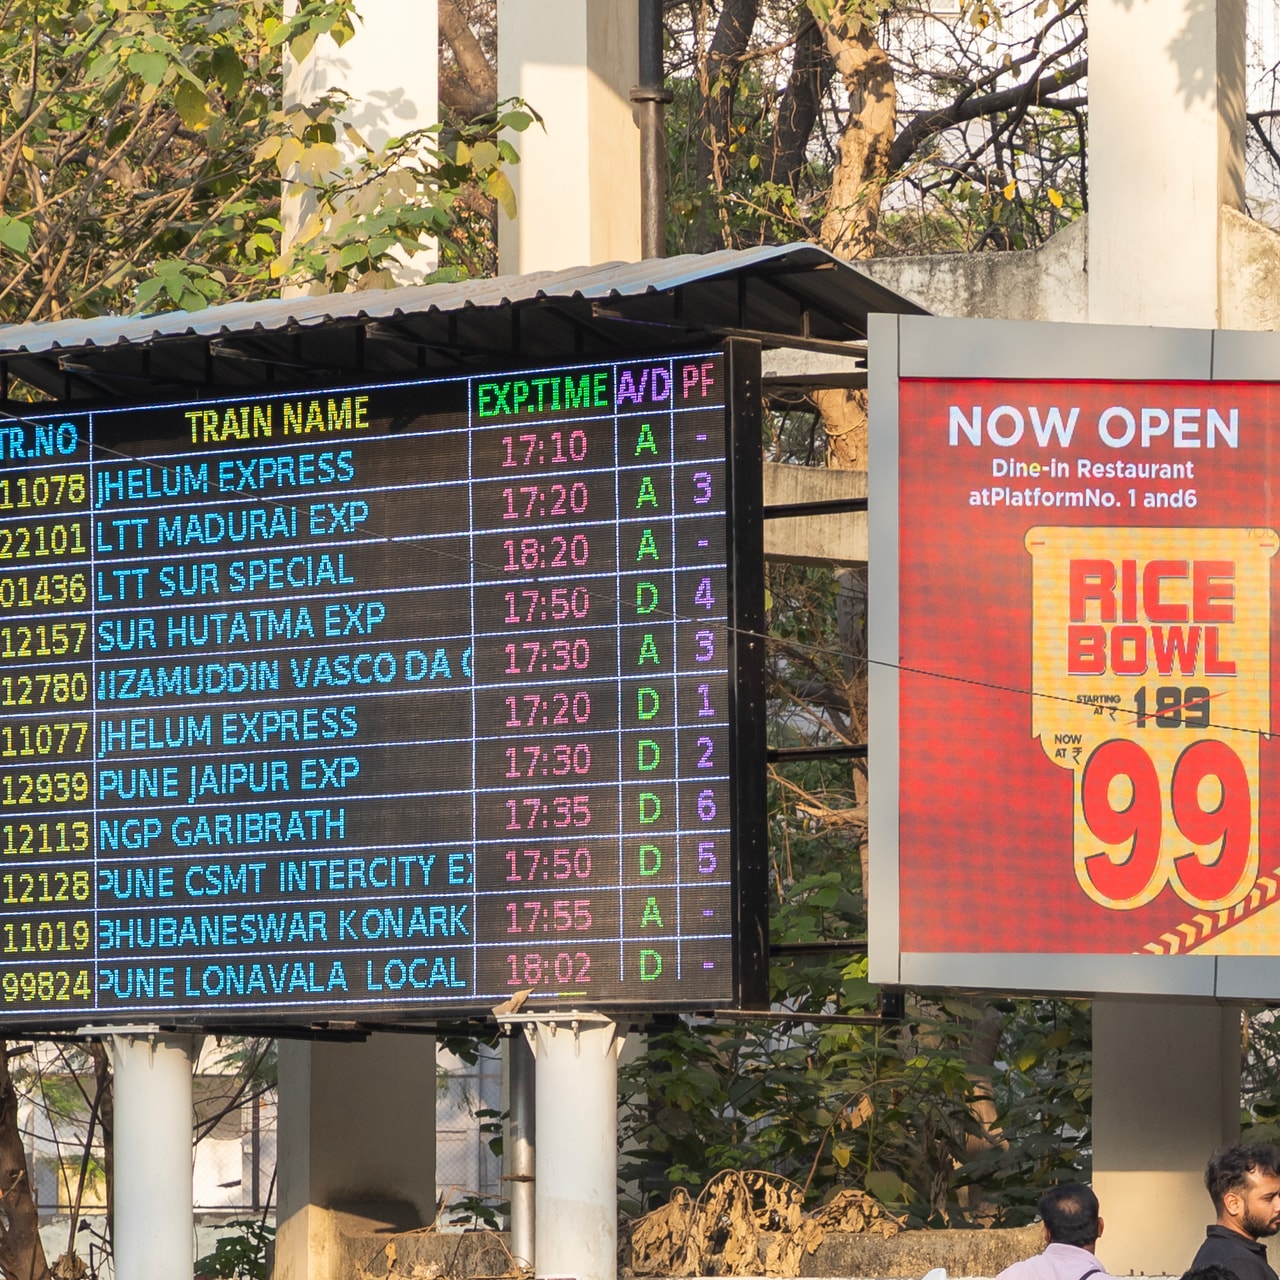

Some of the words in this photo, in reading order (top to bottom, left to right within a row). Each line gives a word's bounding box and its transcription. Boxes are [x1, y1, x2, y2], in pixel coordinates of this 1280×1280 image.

[0, 422, 78, 459] TR.NO
[185, 405, 272, 443] TRAIN
[283, 396, 369, 436] NAME
[478, 373, 608, 417] EXP.TIME
[617, 367, 671, 404] A/D
[683, 363, 714, 398] PF
[949, 406, 1080, 447] NOW
[1098, 406, 1239, 448] OPEN
[0, 473, 86, 509] 11078
[95, 463, 208, 508] JHELUM
[219, 451, 355, 492] EXPRESS
[502, 430, 587, 467] 17:10
[634, 424, 658, 456] A
[992, 458, 1069, 478] Dine-in
[1077, 459, 1194, 479] Restaurant
[0, 523, 86, 559] 22101
[97, 518, 149, 551] LTT
[158, 507, 297, 547] MADURAI
[310, 501, 369, 535] EXP
[502, 482, 588, 520] 17:20
[635, 477, 658, 509] A
[693, 472, 711, 504] 3
[1128, 489, 1135, 507] 1
[0, 573, 87, 607] 01436
[97, 568, 149, 601] LTT
[159, 563, 219, 597] SUR
[228, 554, 354, 591] SPECIAL
[503, 534, 589, 572] 18:20
[636, 529, 659, 561] A
[1069, 559, 1236, 623] RICE
[1, 623, 87, 658] 12157
[98, 618, 156, 652] SUR
[168, 607, 314, 648] HUTATMA
[325, 602, 385, 636] EXP
[504, 587, 589, 623] 17:50
[636, 582, 658, 614] D
[694, 578, 715, 609] 4
[1, 672, 87, 706] 12780
[290, 651, 397, 687] VASCO
[405, 648, 452, 680] DA
[504, 639, 590, 674] 17:30
[637, 635, 660, 665] A
[695, 630, 715, 662] 3
[1067, 625, 1238, 677] BOWL
[1, 722, 89, 756] 11077
[98, 715, 211, 758] JHELUM
[223, 706, 358, 745] EXPRESS
[505, 691, 591, 727] 17:20
[638, 687, 660, 720] D
[698, 684, 715, 717] 1
[1077, 695, 1121, 704] STARTING
[1093, 707, 1104, 716] AT
[1134, 686, 1210, 728] 189
[1054, 734, 1082, 744] NOW
[1055, 748, 1067, 758] AT
[2, 772, 88, 805] 12939
[99, 767, 179, 800] PUNE
[188, 761, 290, 804] JAIPUR
[301, 757, 360, 789] EXP
[505, 743, 591, 779] 17:30
[638, 739, 660, 771] D
[697, 736, 714, 768] 2
[3, 821, 89, 855] 12113
[99, 818, 162, 850] NGP
[171, 808, 345, 847] GARIBRATH
[505, 796, 592, 830] 17:35
[639, 793, 661, 824] D
[698, 789, 716, 821] 6
[1081, 738, 1252, 902] 99
[3, 871, 89, 904] 12128
[185, 863, 266, 896] CSMT
[280, 854, 436, 891] INTERCITY
[505, 848, 592, 882] 17:50
[640, 845, 662, 877] D
[698, 842, 717, 874] 5
[3, 921, 89, 953] 11019
[99, 911, 326, 950] BHUBANESWAR
[339, 904, 470, 940] KONARK
[506, 900, 592, 933] 17:55
[640, 897, 663, 928] A
[2, 970, 90, 1002] 99824
[185, 961, 348, 998] LONAVALA
[367, 957, 466, 991] LOCAL
[506, 952, 591, 985] 18:02
[640, 950, 662, 981] D
